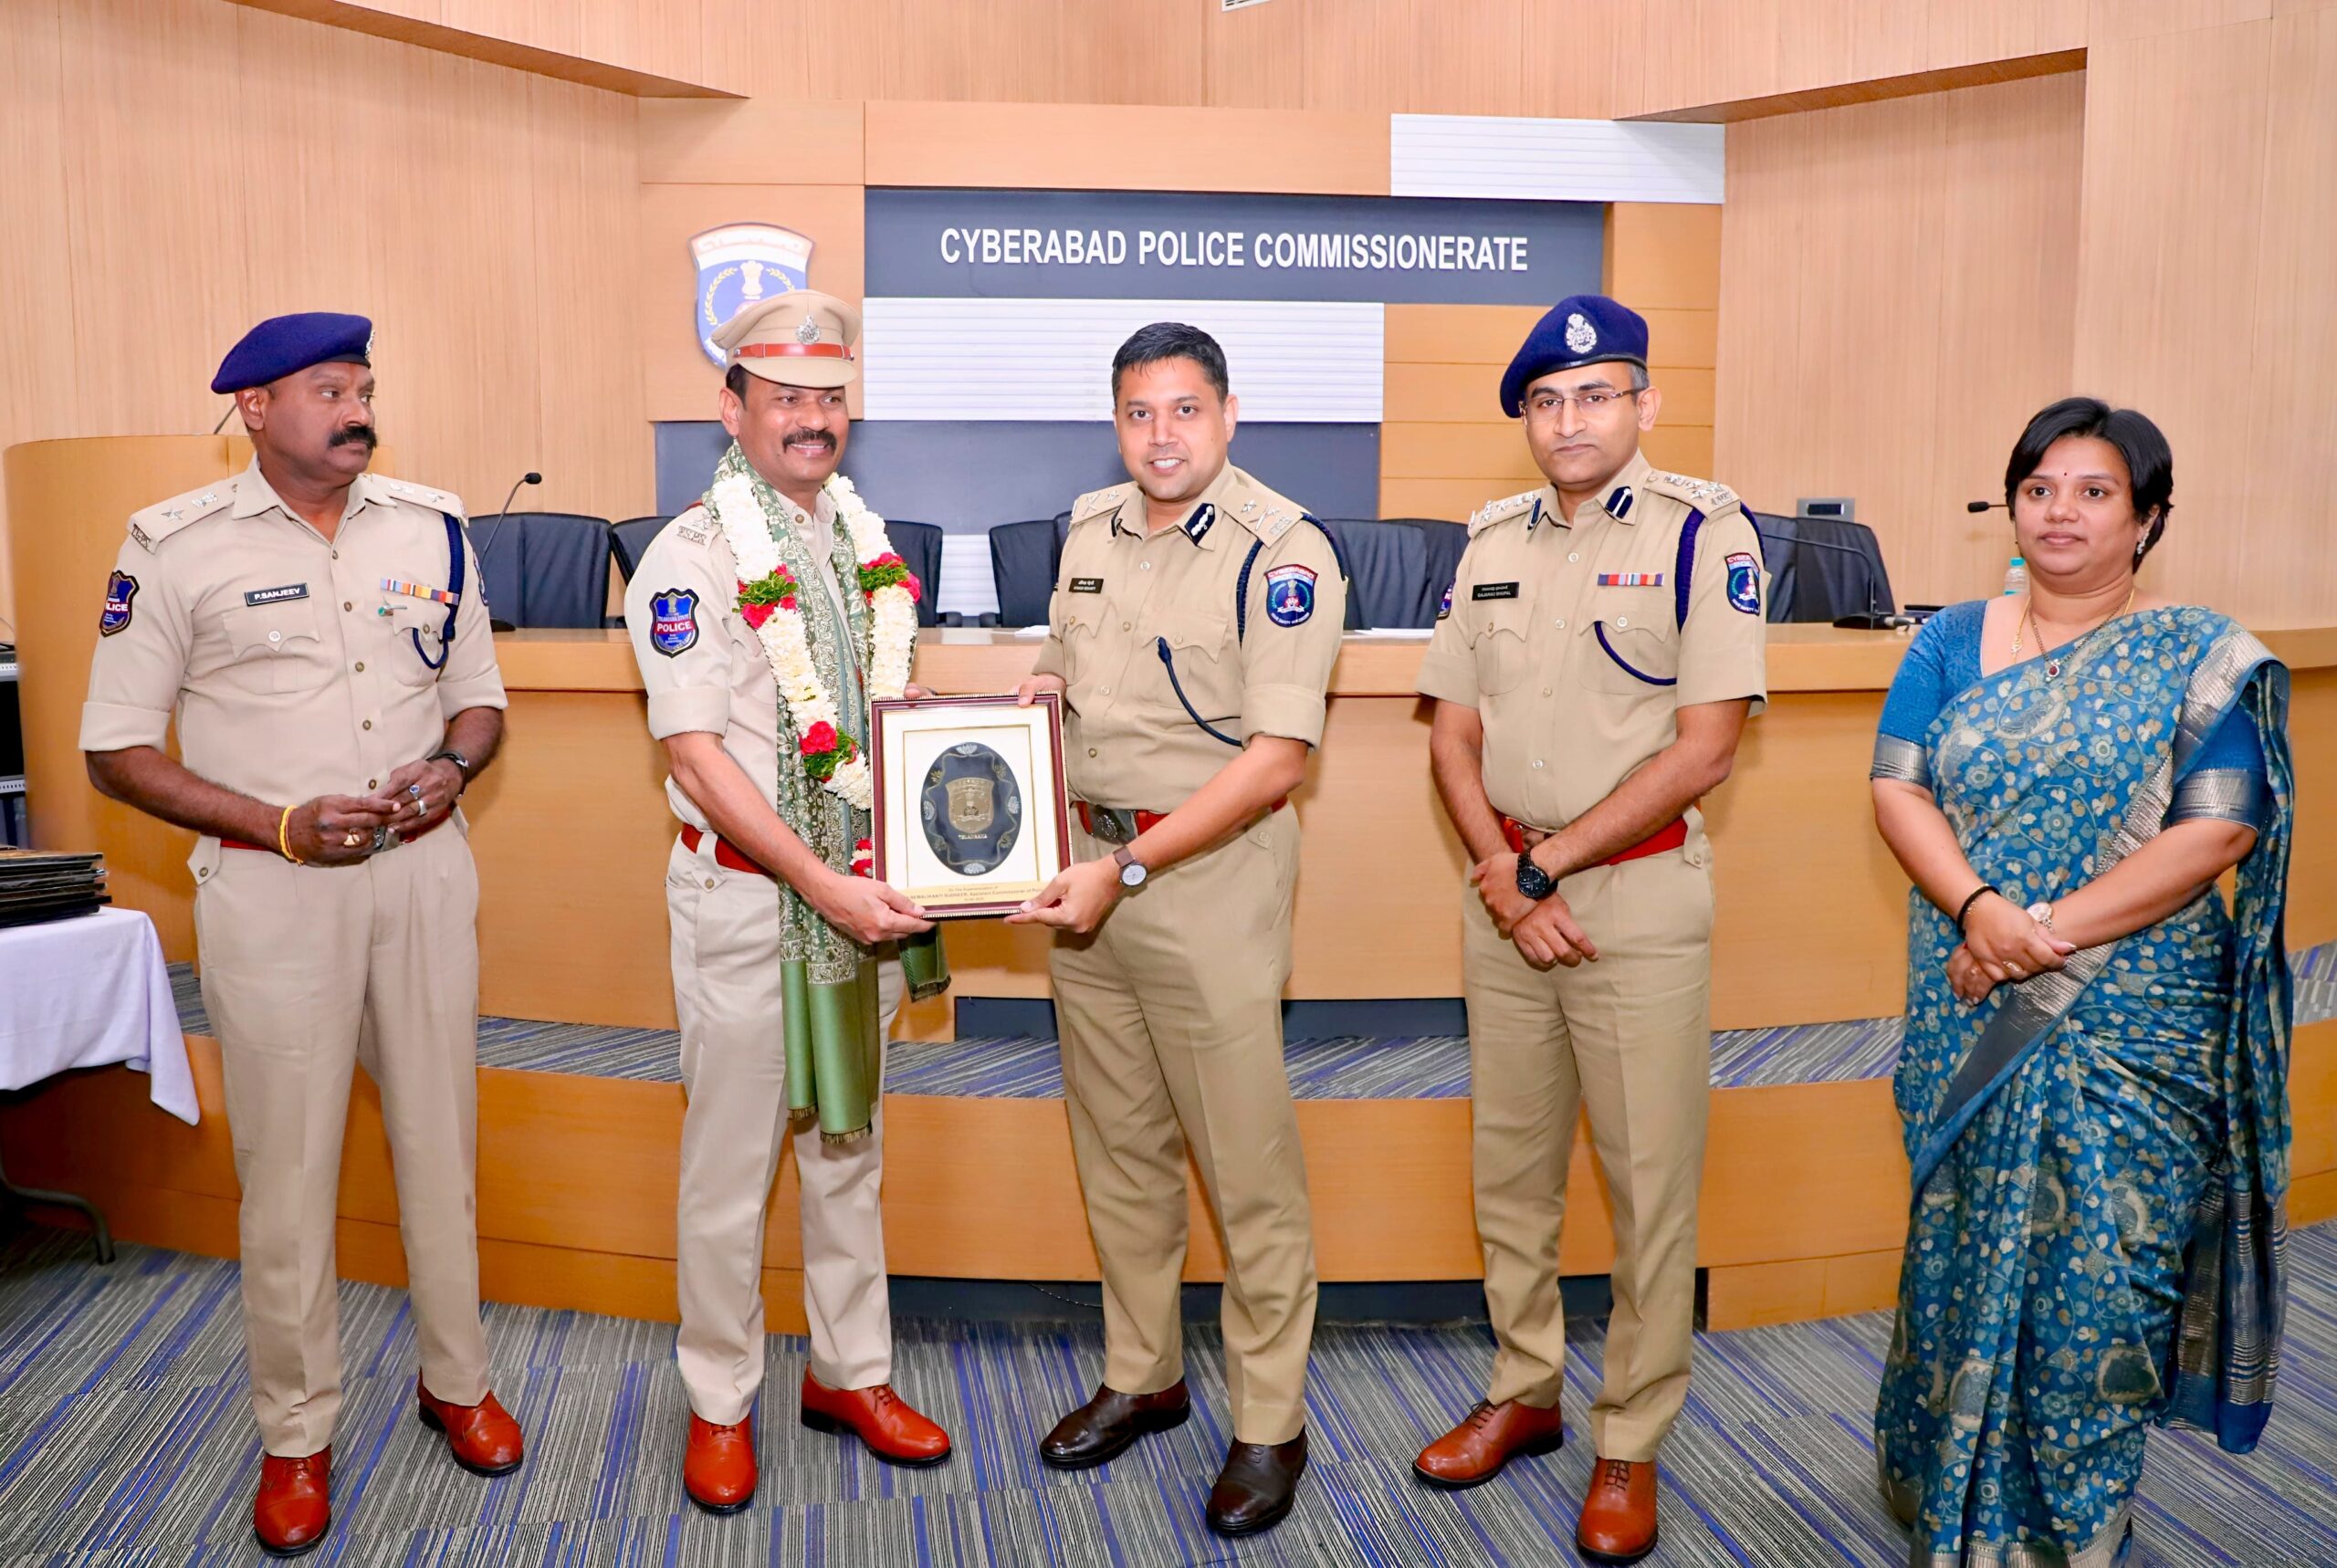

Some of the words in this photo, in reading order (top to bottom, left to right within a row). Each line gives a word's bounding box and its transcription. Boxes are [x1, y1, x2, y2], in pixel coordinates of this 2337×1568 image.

[940, 228, 1127, 265] CYBERABAD
[1139, 230, 1244, 267] POLICE
[1254, 233, 1528, 271] COMMISSIONERATE
[254, 588, 300, 601] P.SANJEEV
[106, 603, 129, 612] LICE
[656, 621, 693, 632] POLICE
